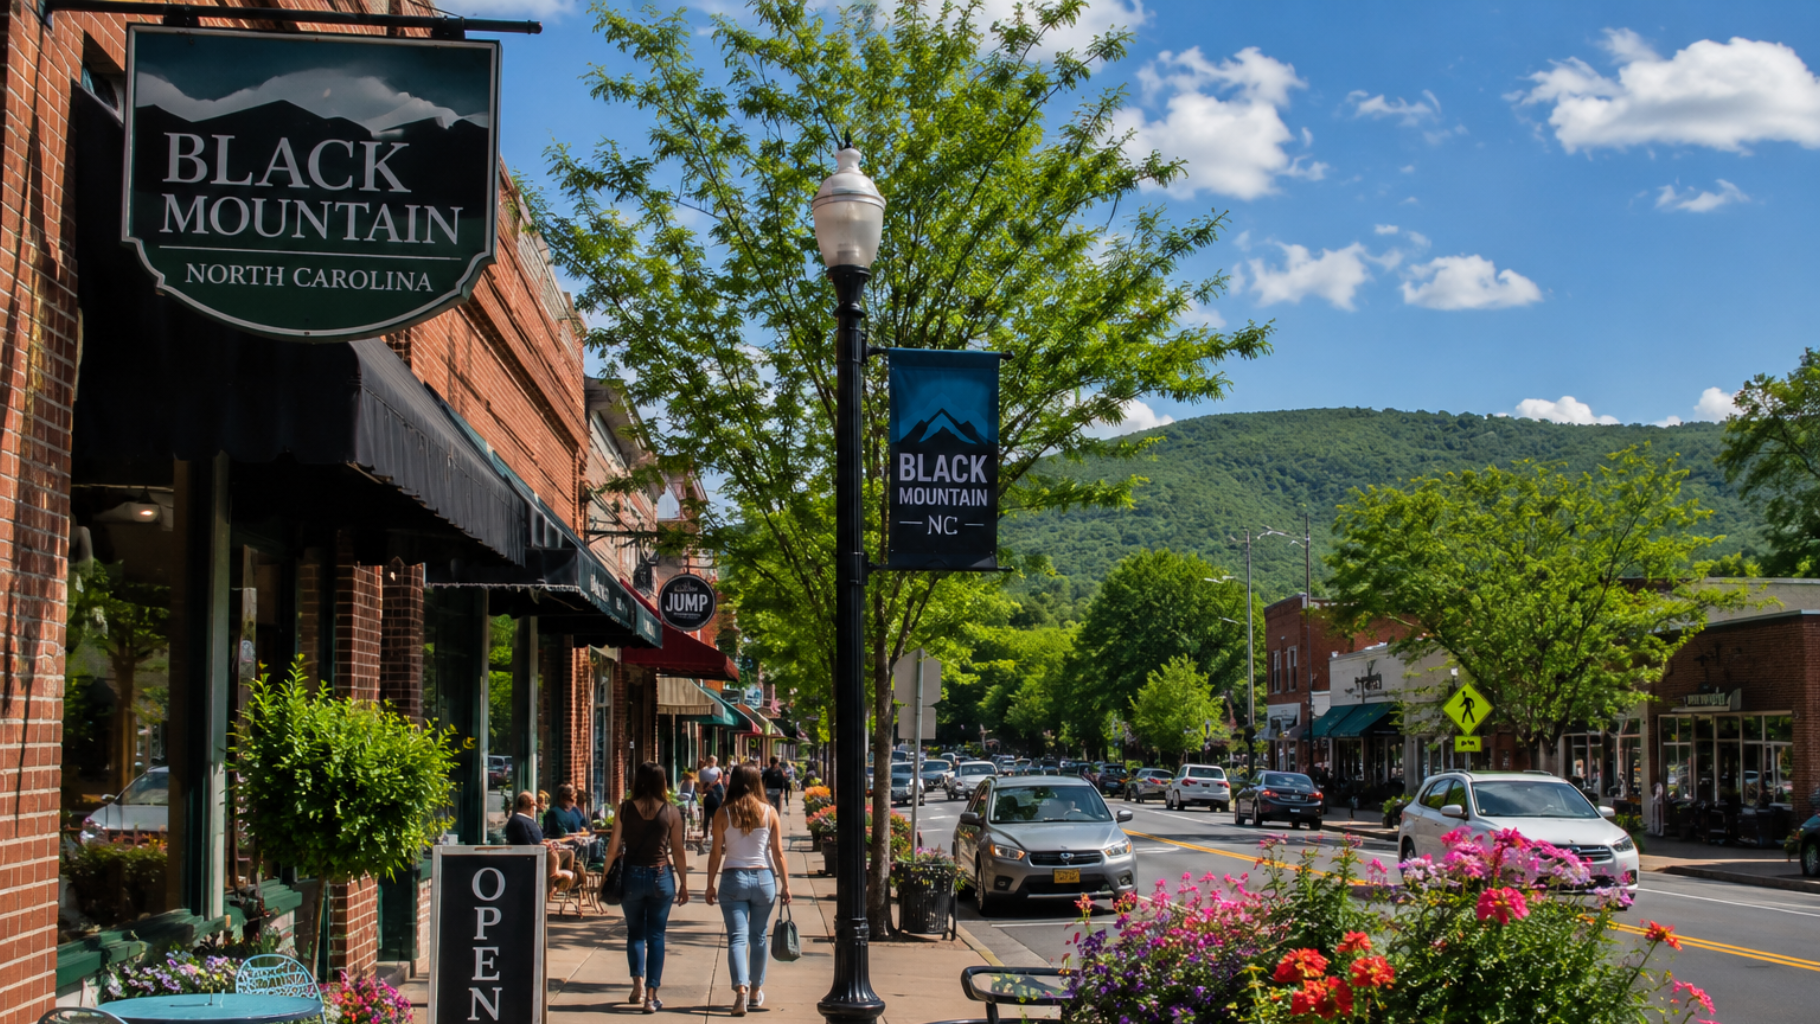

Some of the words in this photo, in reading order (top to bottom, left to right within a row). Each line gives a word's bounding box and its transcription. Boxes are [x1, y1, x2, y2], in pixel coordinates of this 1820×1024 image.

[161, 132, 412, 193] BLACK
[158, 193, 464, 246] MOUNTAIN
[185, 262, 285, 287] NORTH
[293, 267, 434, 292] CAROLINA
[898, 452, 988, 484] BLACK
[898, 487, 988, 507] MOUNTAIN
[927, 514, 958, 536] NC
[665, 592, 709, 612] JUMP
[467, 866, 507, 1021] OPEN
